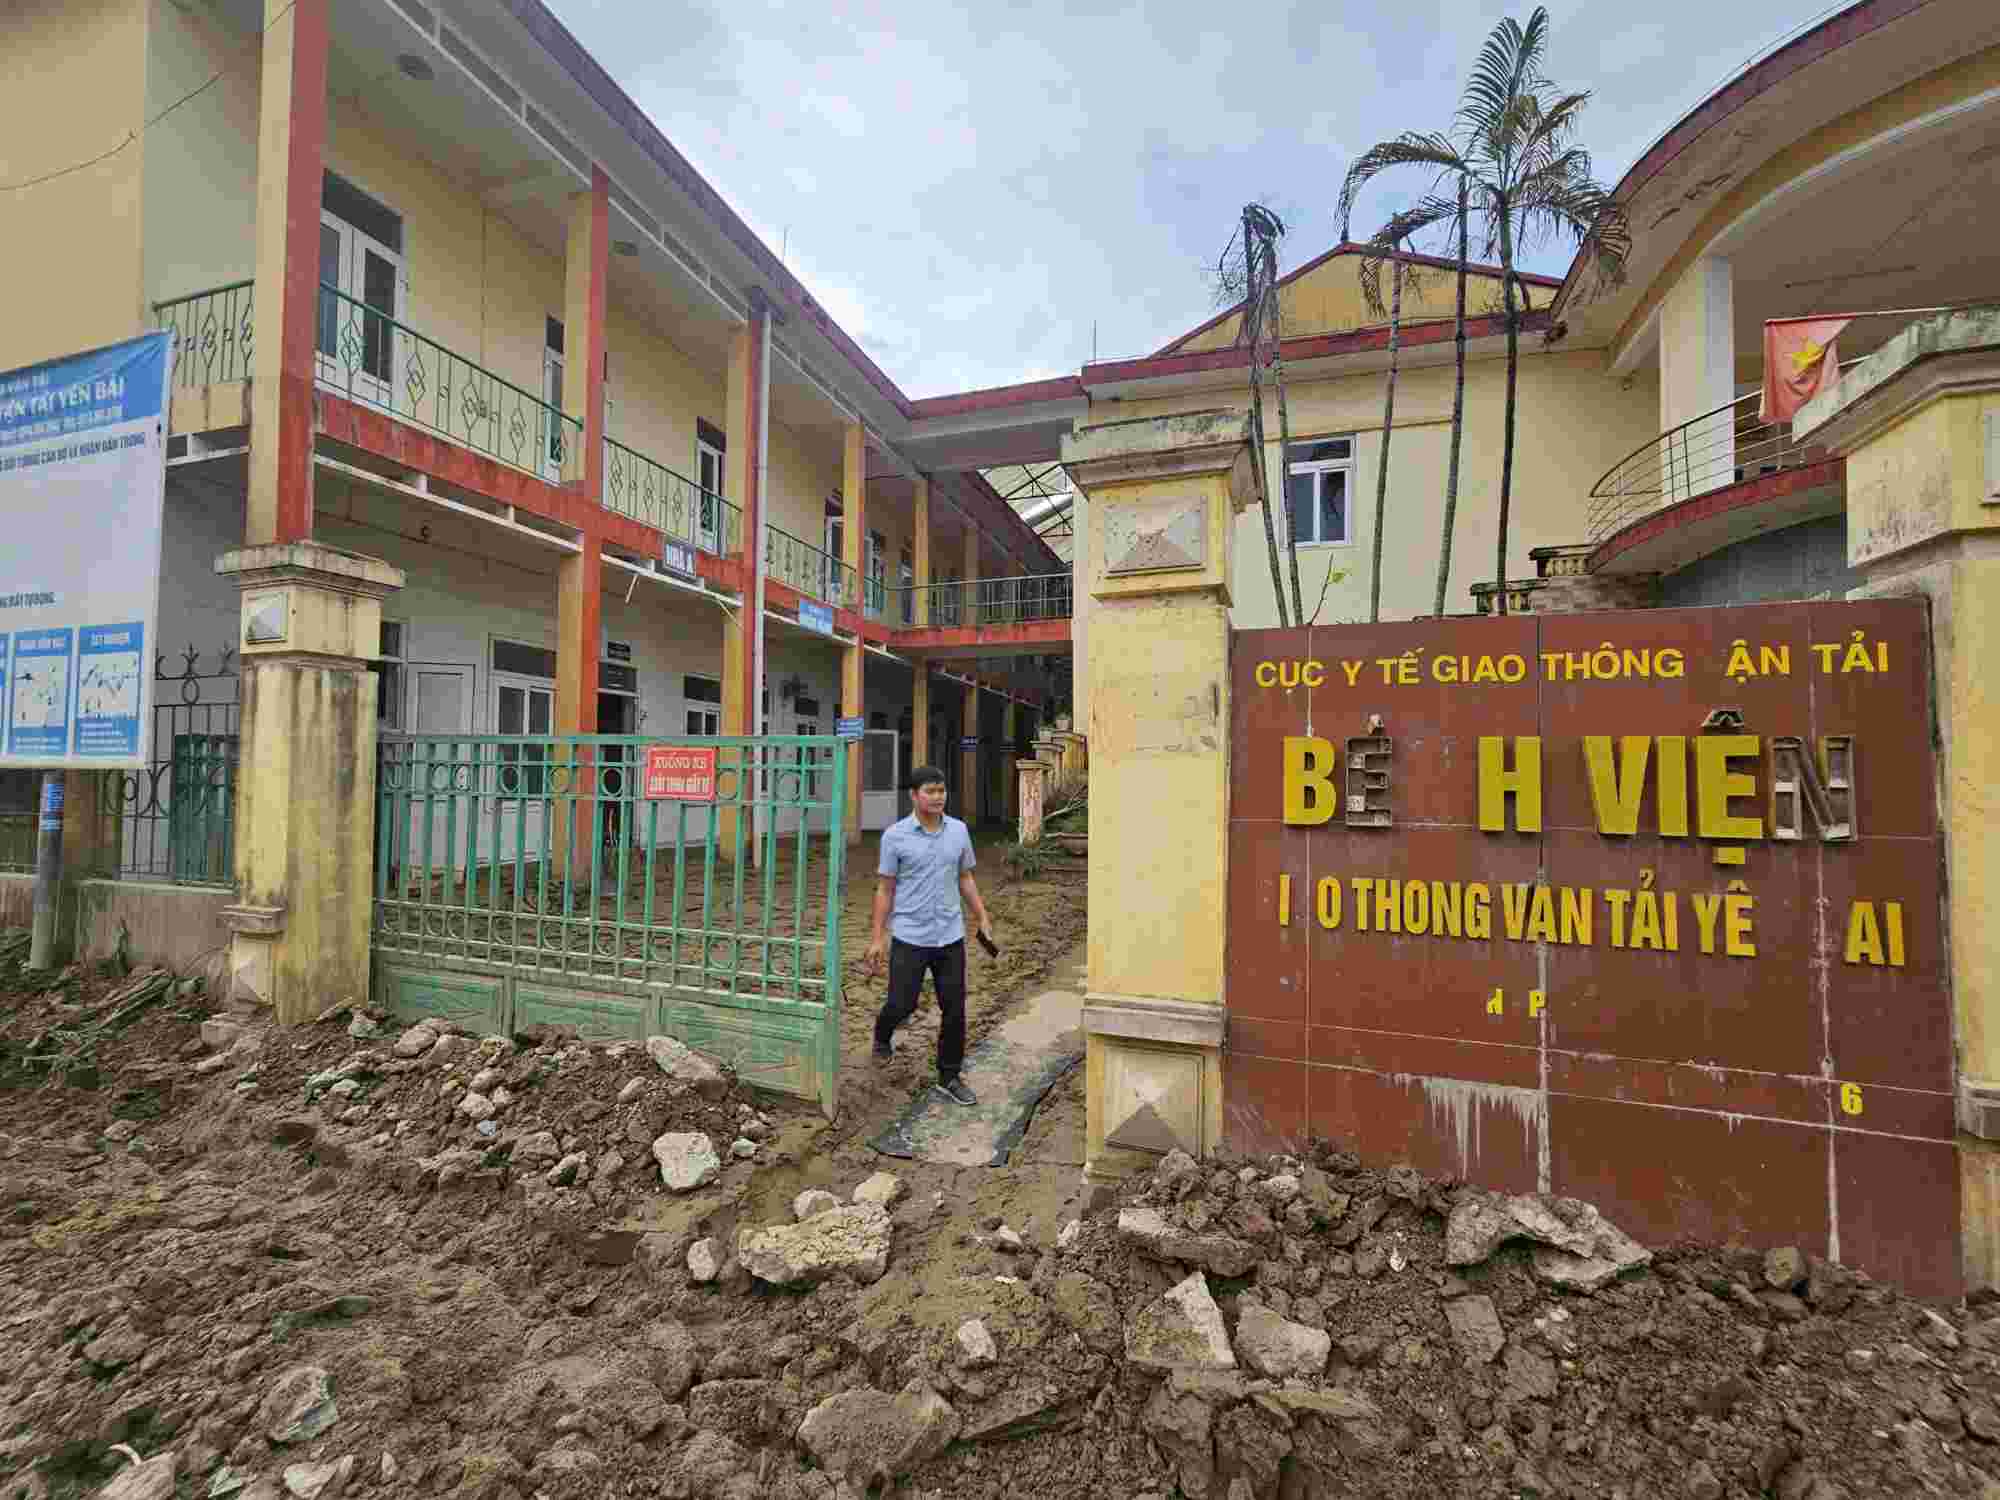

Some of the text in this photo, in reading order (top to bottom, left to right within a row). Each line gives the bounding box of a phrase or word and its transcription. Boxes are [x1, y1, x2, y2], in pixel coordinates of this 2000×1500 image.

[1255, 660, 1325, 695] CỤC
[1342, 661, 1364, 687] Y
[1376, 647, 1425, 685] TẾ
[1431, 654, 1527, 684] GIAO
[1540, 641, 1686, 681] THÔNG
[1811, 629, 1889, 673] TẢI
[1583, 708, 1858, 864] VIỆN
[1604, 867, 1679, 951] TẢI
[1840, 1083, 1863, 1115] 6
